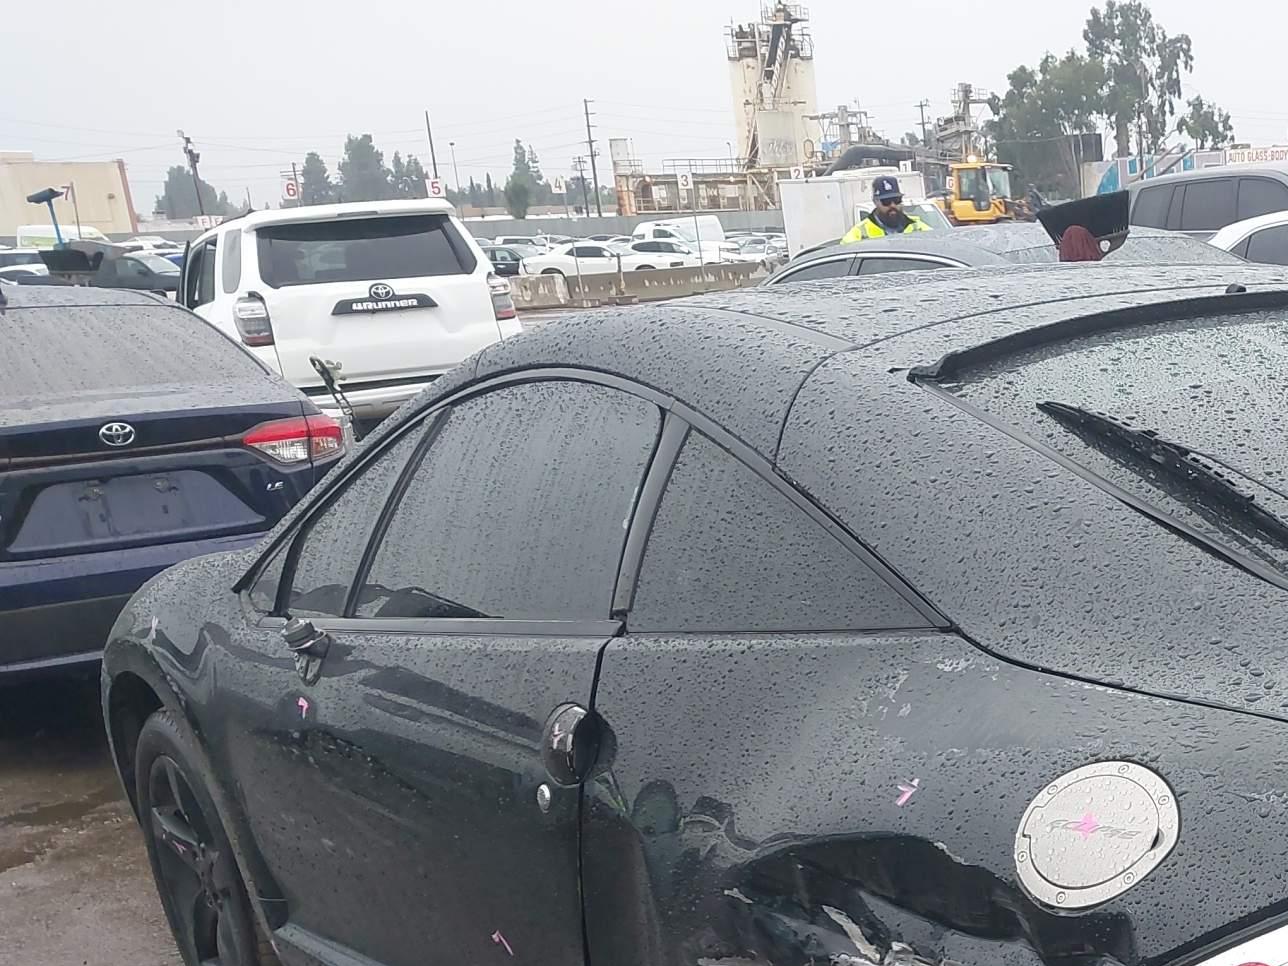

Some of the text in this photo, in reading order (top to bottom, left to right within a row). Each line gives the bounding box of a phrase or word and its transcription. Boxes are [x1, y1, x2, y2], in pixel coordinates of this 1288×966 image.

[1228, 151, 1246, 163] AUTO
[431, 181, 442, 195] 5
[554, 175, 563, 191] 4
[680, 174, 689, 188] 3
[61, 186, 70, 200] 7
[286, 182, 297, 197] 6
[266, 481, 284, 491] LE
